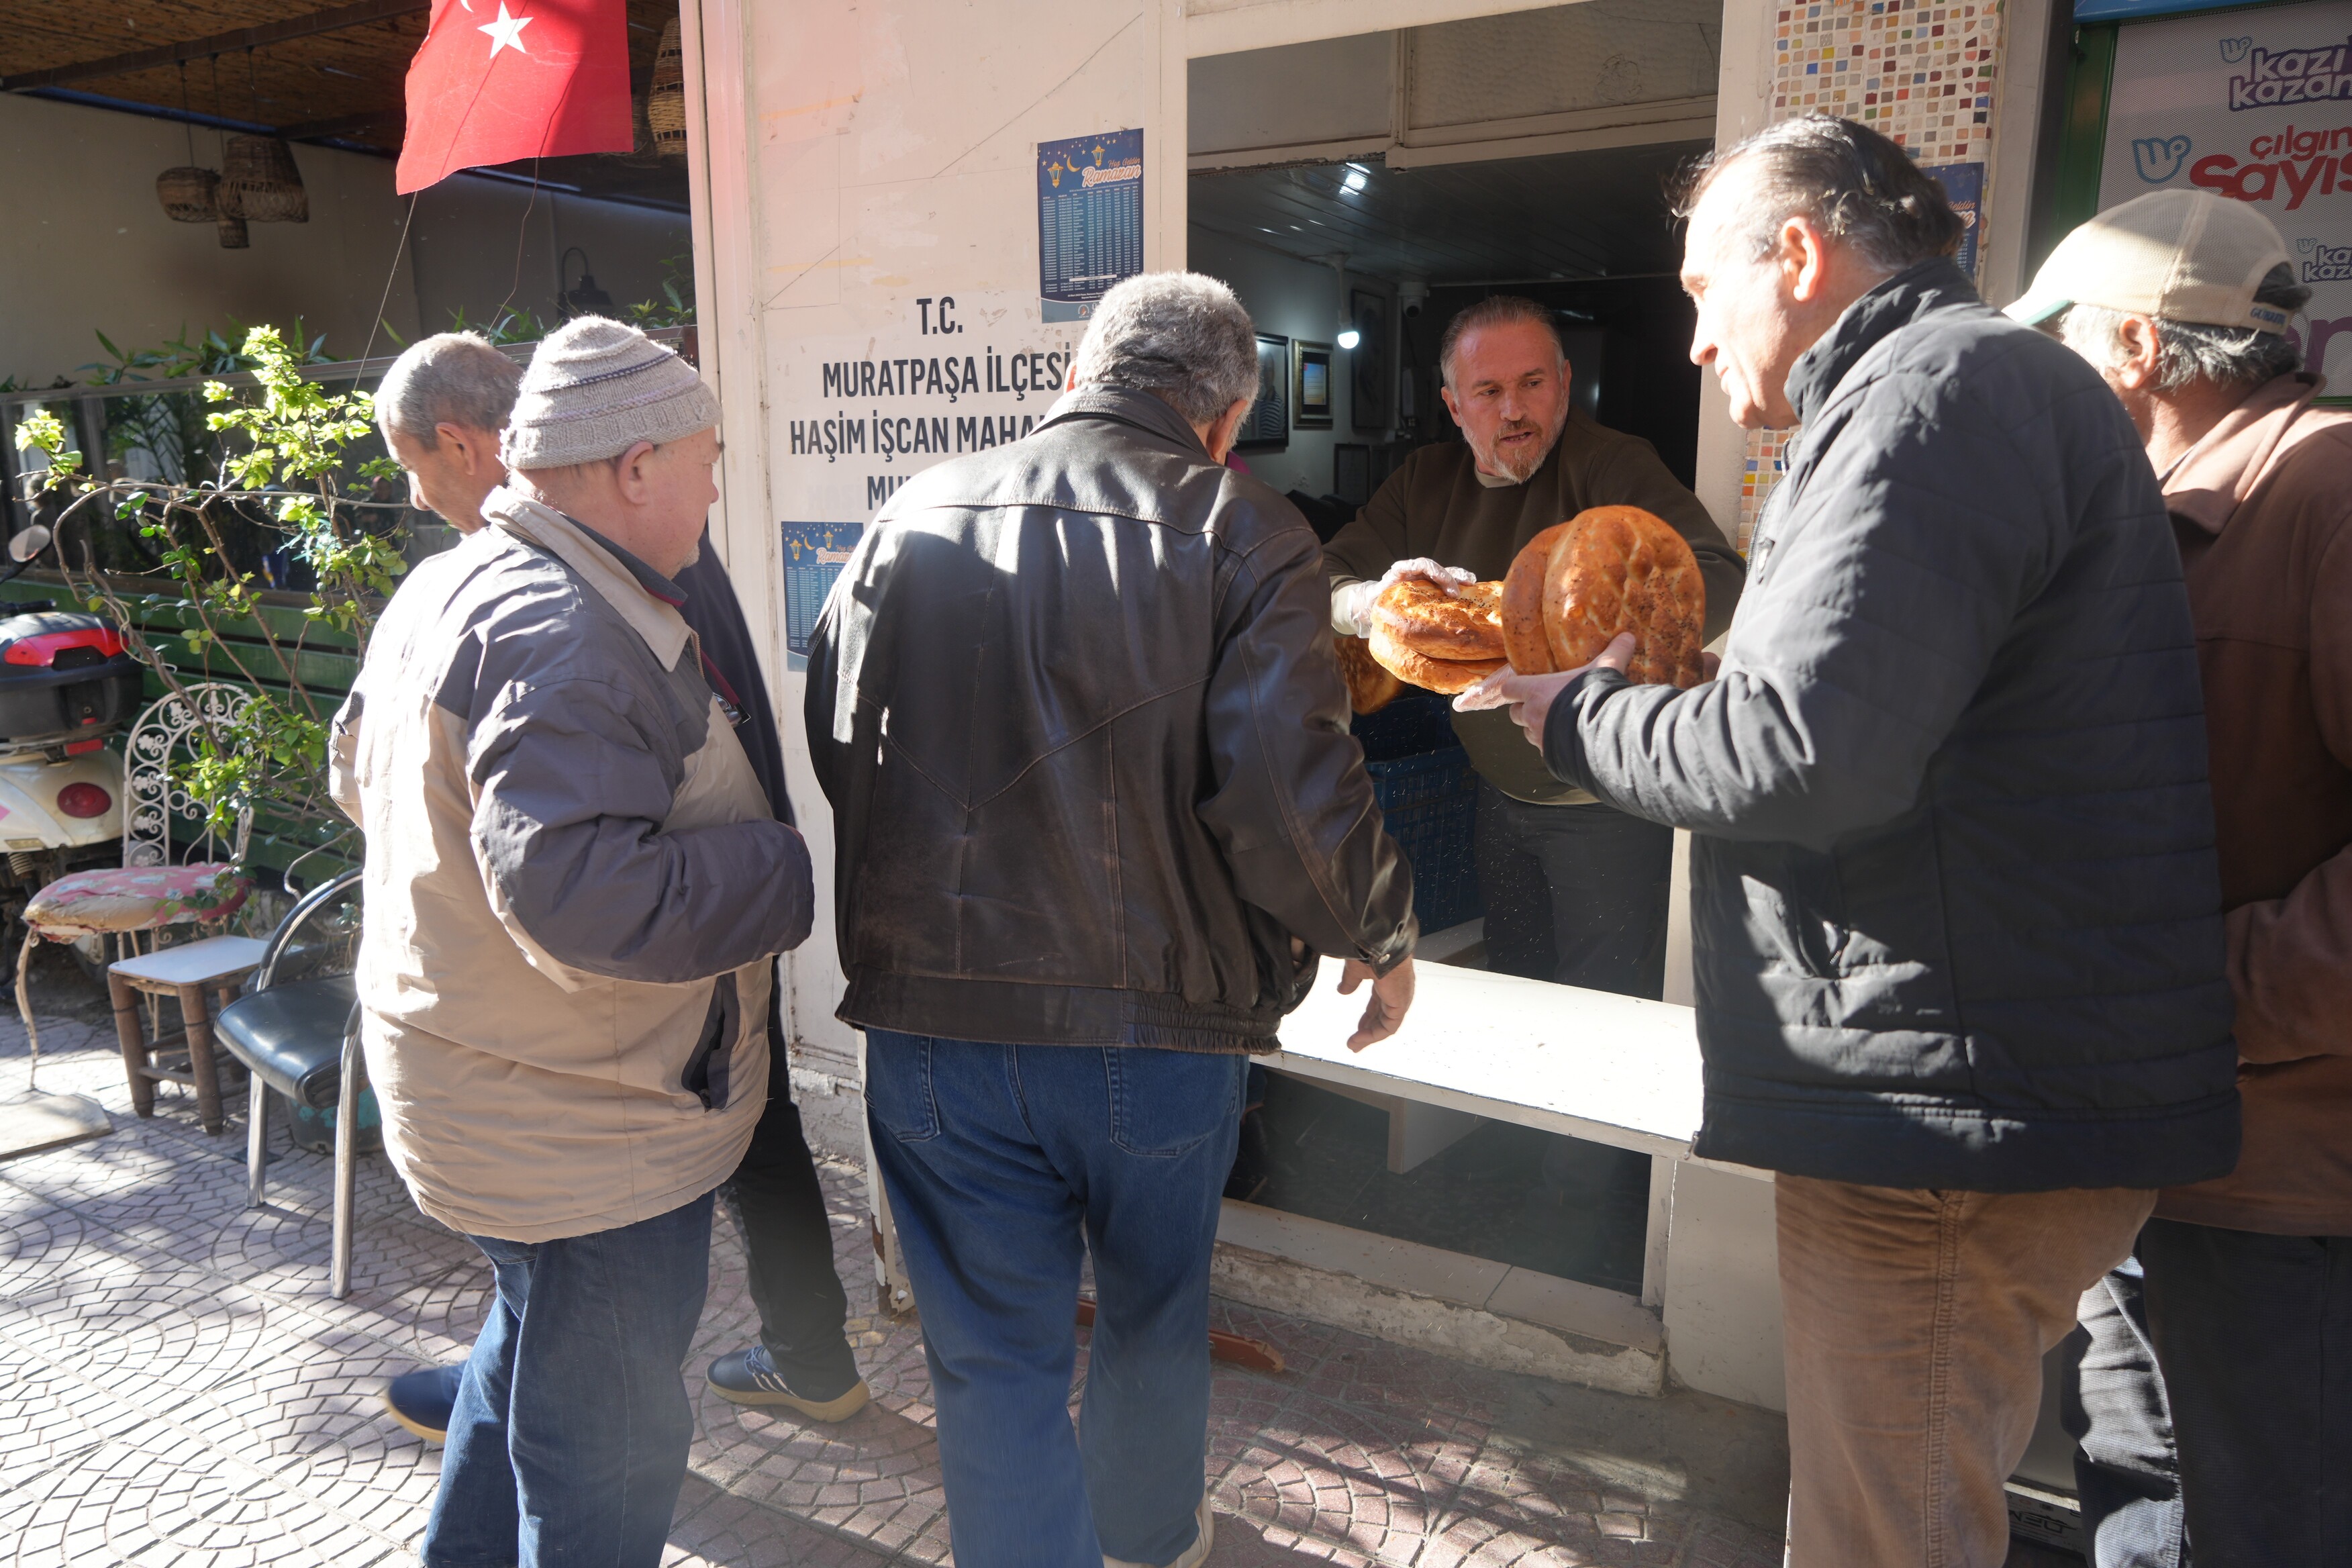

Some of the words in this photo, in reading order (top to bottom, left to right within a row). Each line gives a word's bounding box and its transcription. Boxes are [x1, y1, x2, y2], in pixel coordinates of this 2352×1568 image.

[1082, 164, 1141, 187] Ramazan
[1122, 156, 1140, 166] Geldin
[916, 296, 963, 335] T.C.
[823, 356, 979, 403] MURATPAŞA
[790, 410, 866, 463] HAŞİM
[872, 409, 949, 462] İŞCAN
[957, 415, 1045, 453] MAHA
[816, 547, 853, 565] Ramaz
